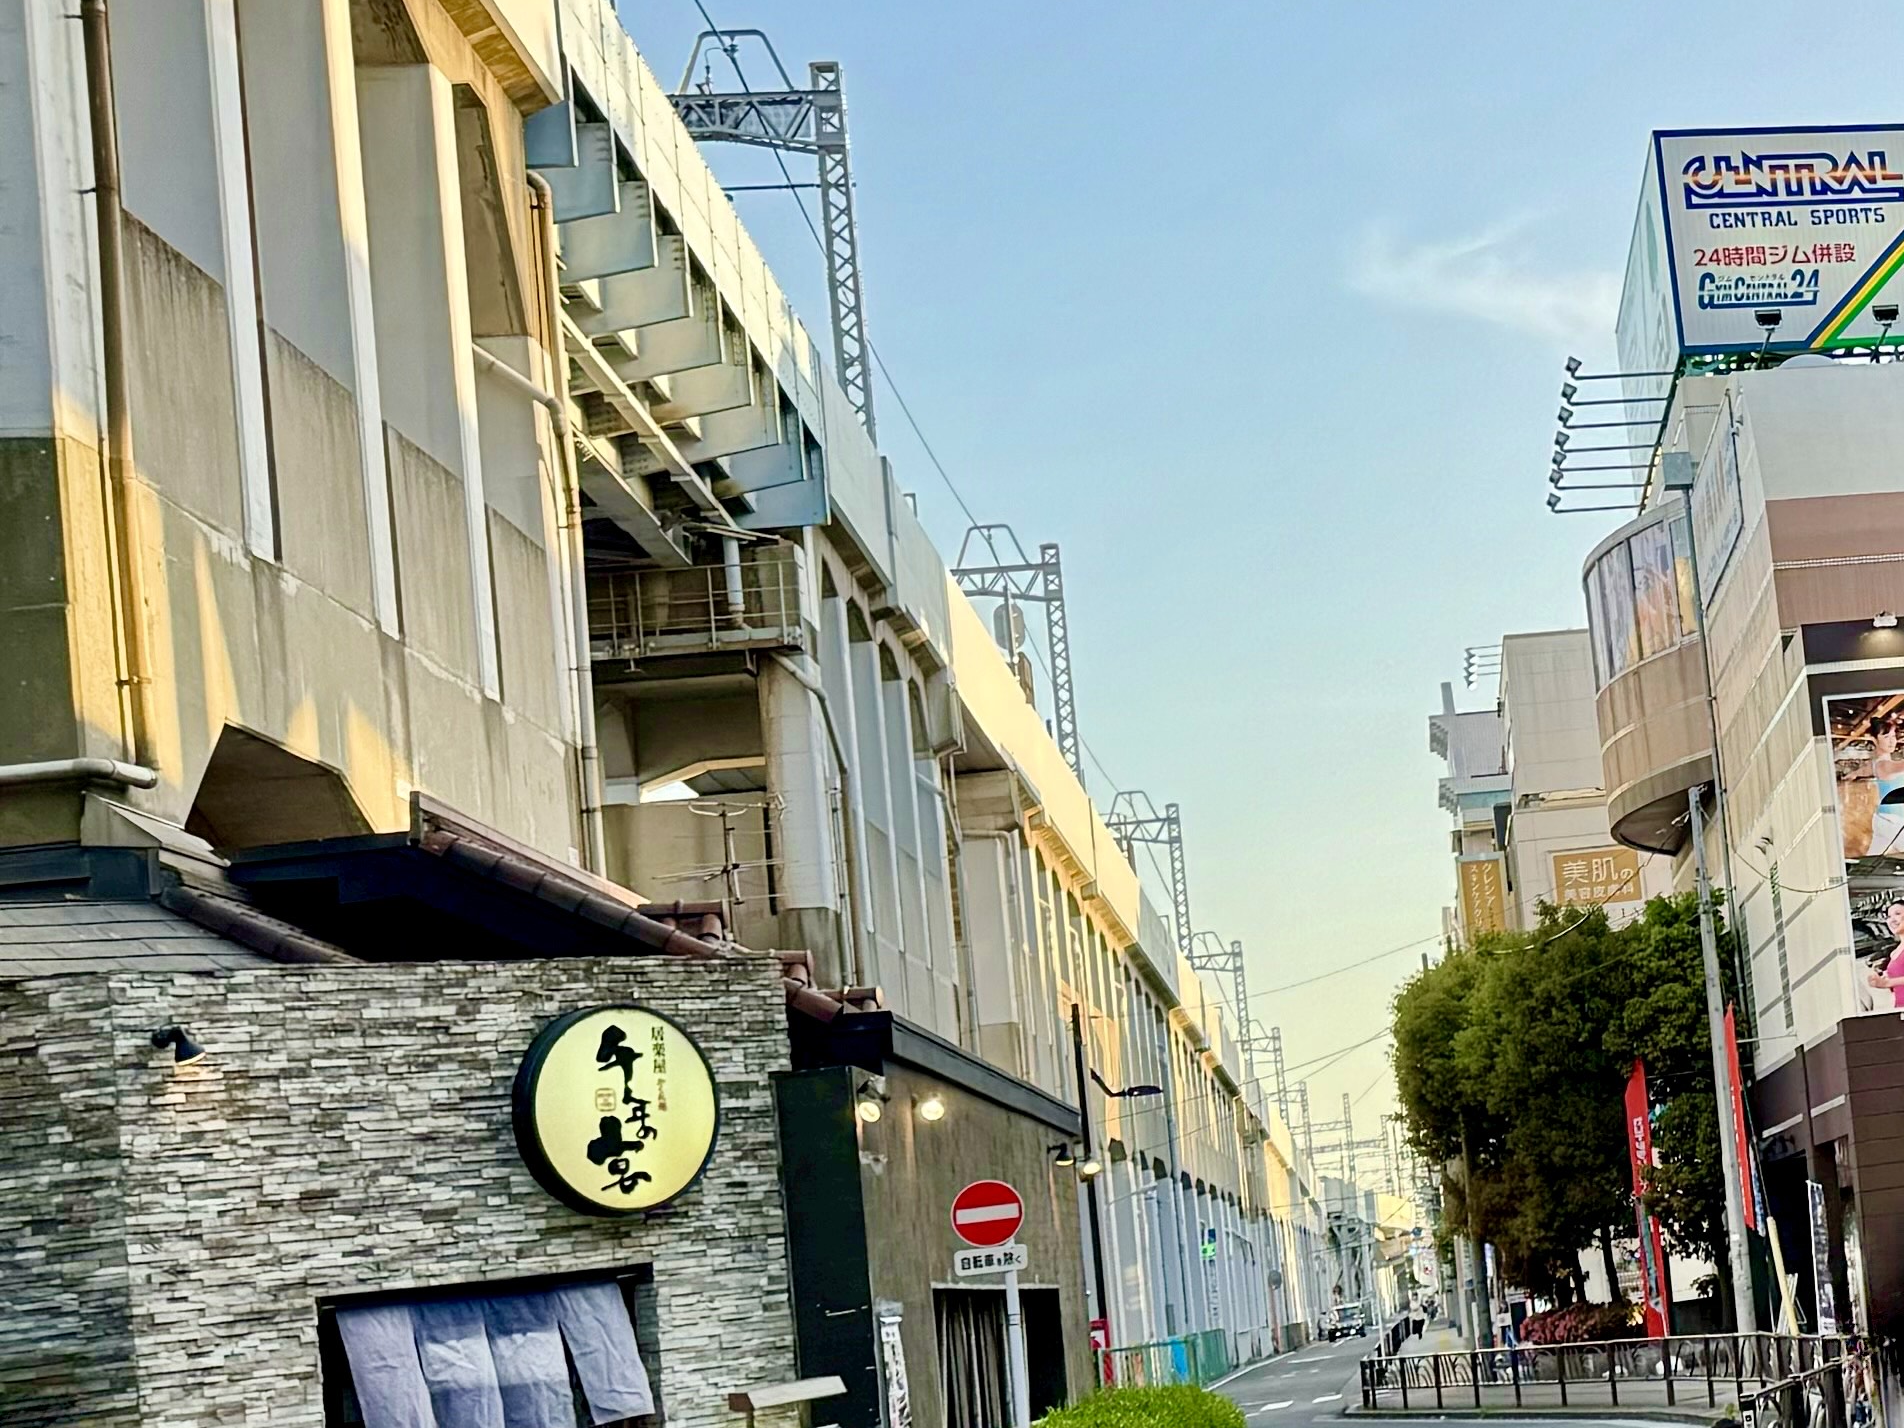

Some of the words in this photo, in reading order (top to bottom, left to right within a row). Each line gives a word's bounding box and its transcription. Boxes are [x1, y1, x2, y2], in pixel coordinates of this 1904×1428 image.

[1709, 211, 1798, 229] CENTRAL
[1811, 207, 1886, 226] SPORTS
[1693, 243, 1856, 267] 24時間ジム併設
[1562, 856, 1634, 887] 美肌の
